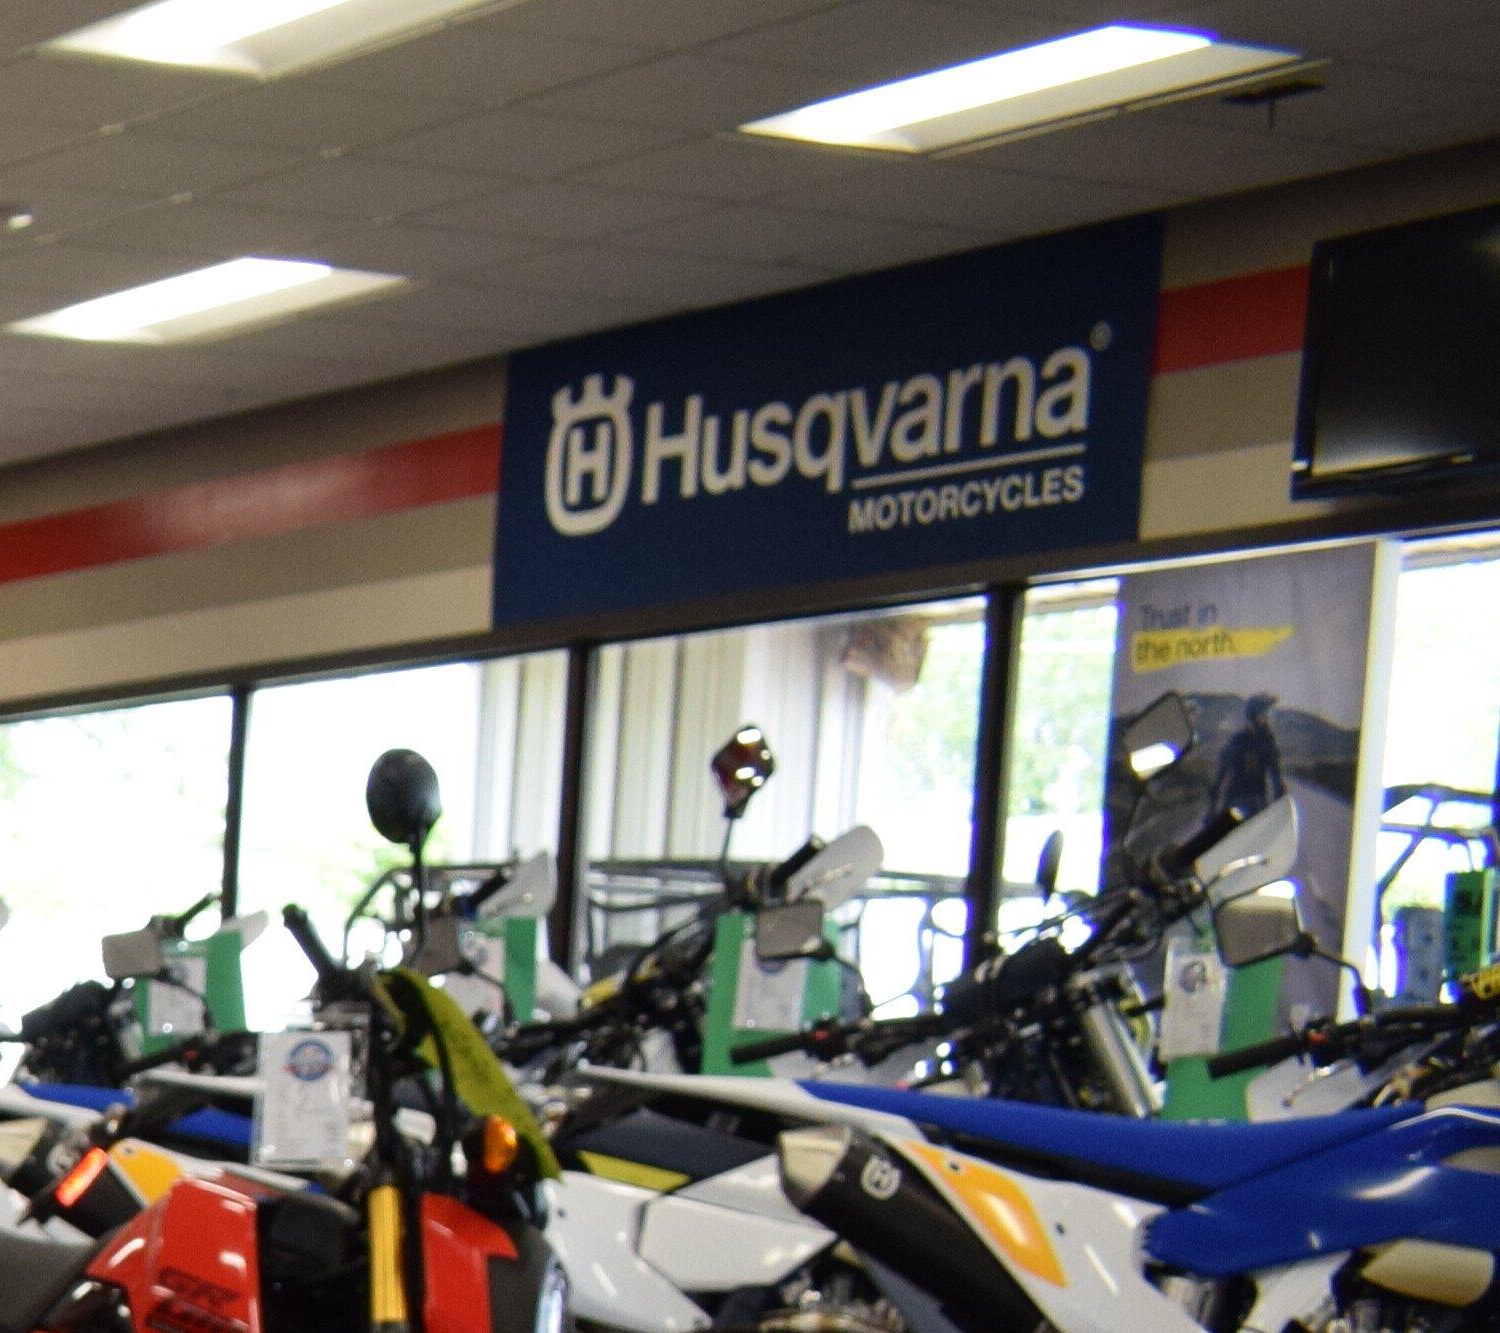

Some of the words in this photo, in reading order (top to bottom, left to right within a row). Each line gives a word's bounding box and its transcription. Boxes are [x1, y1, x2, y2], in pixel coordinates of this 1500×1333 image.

[643, 345, 1091, 504] Husqvarna
[847, 464, 1086, 533] MOTORCYCLES
[1141, 604, 1192, 628] Trust
[1197, 602, 1218, 623] in
[1135, 638, 1171, 662] the
